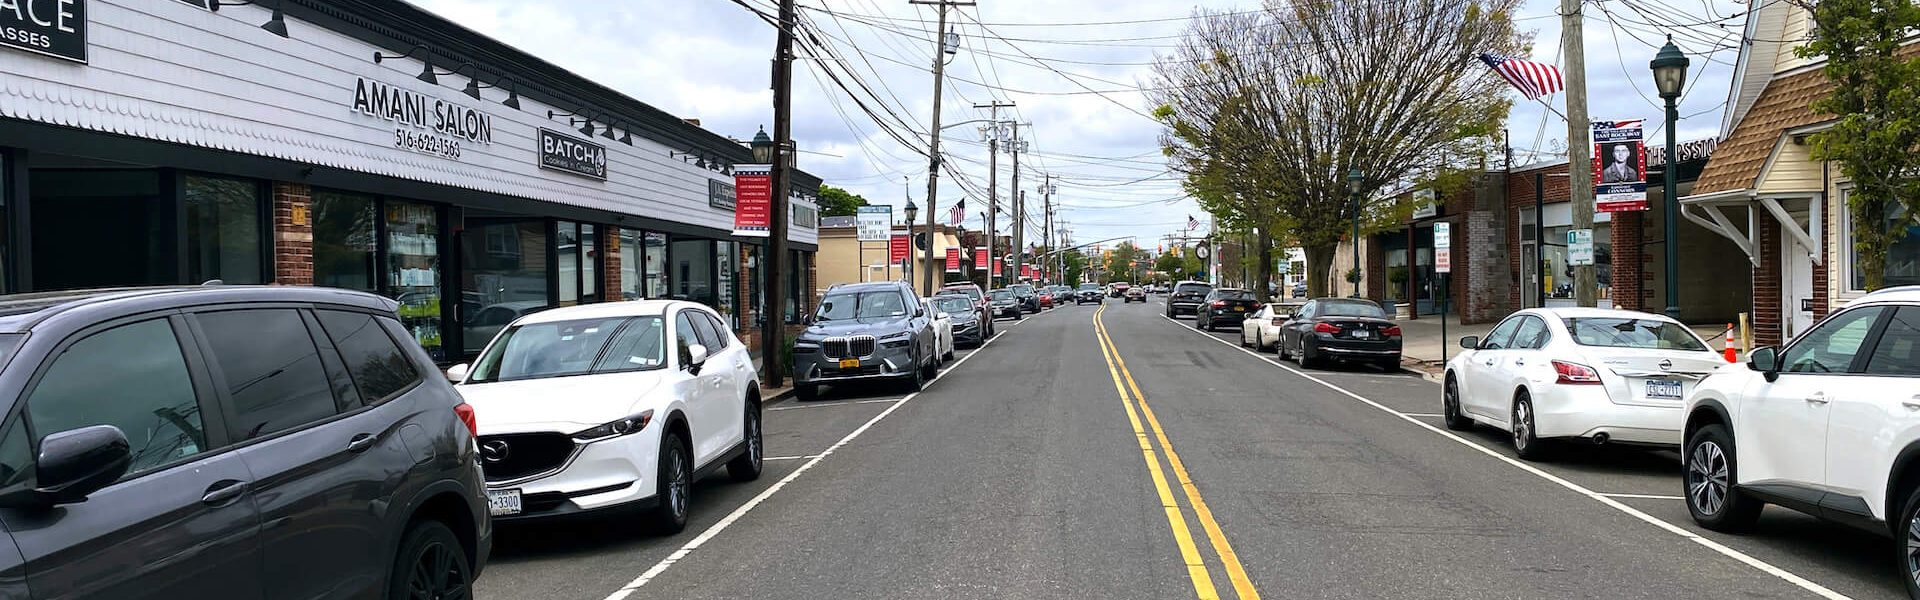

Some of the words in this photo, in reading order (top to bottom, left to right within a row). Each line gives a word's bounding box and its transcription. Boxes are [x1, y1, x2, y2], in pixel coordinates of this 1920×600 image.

[352, 76, 427, 127] AMANI
[434, 99, 492, 144] SALON
[394, 128, 461, 158] 516-622-1563
[544, 135, 595, 165] BATCH
